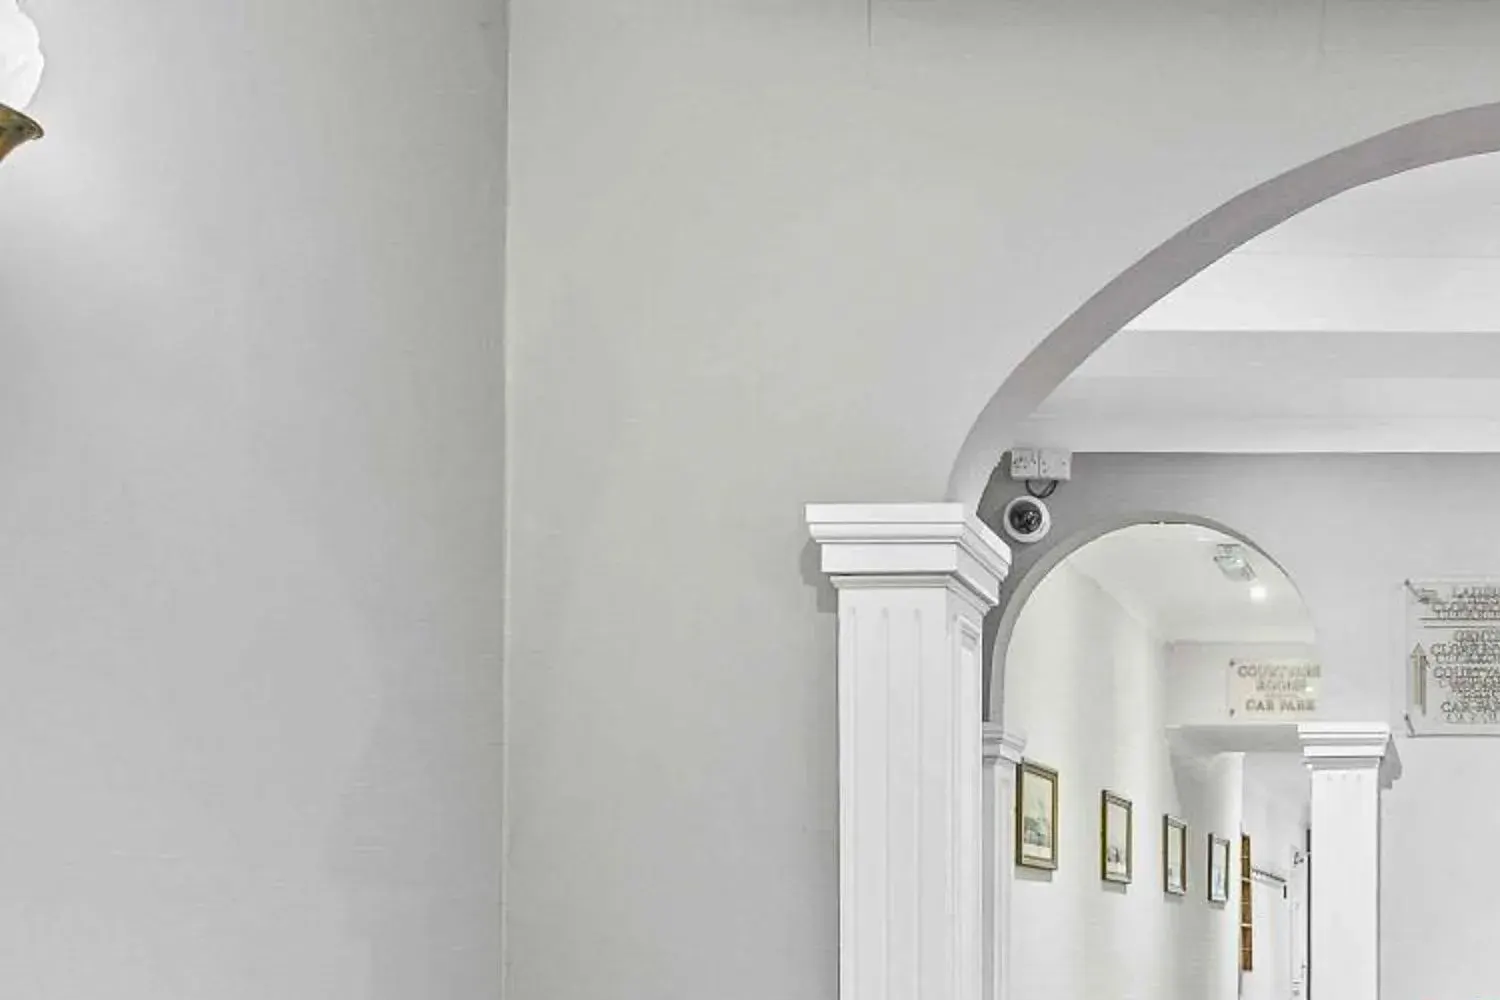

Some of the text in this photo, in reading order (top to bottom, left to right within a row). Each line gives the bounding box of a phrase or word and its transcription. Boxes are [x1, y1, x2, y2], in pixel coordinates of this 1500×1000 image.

[1245, 698, 1316, 711] CAR PARK
[1440, 701, 1473, 713] CAR
